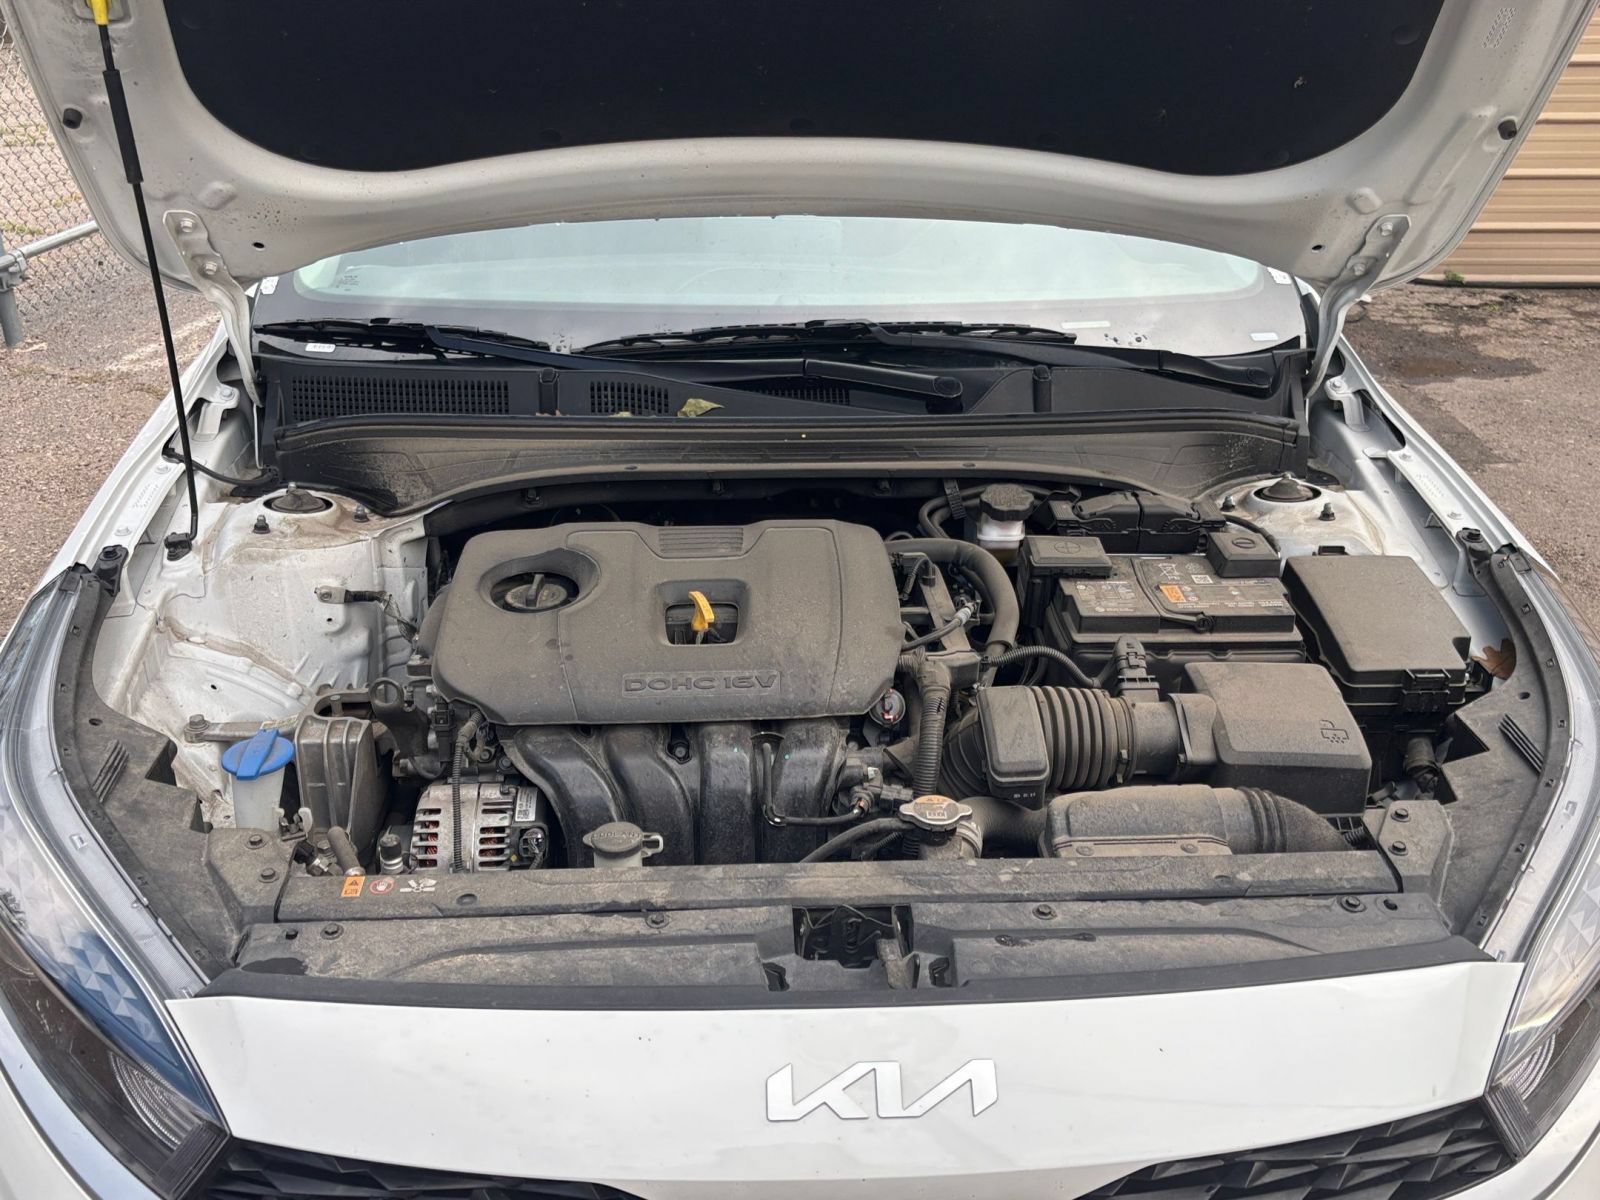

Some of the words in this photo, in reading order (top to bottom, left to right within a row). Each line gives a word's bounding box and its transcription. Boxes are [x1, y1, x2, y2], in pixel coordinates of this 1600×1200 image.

[624, 677, 716, 692] DOHC
[723, 675, 777, 689] 16V
[766, 1059, 998, 1122] KIA
